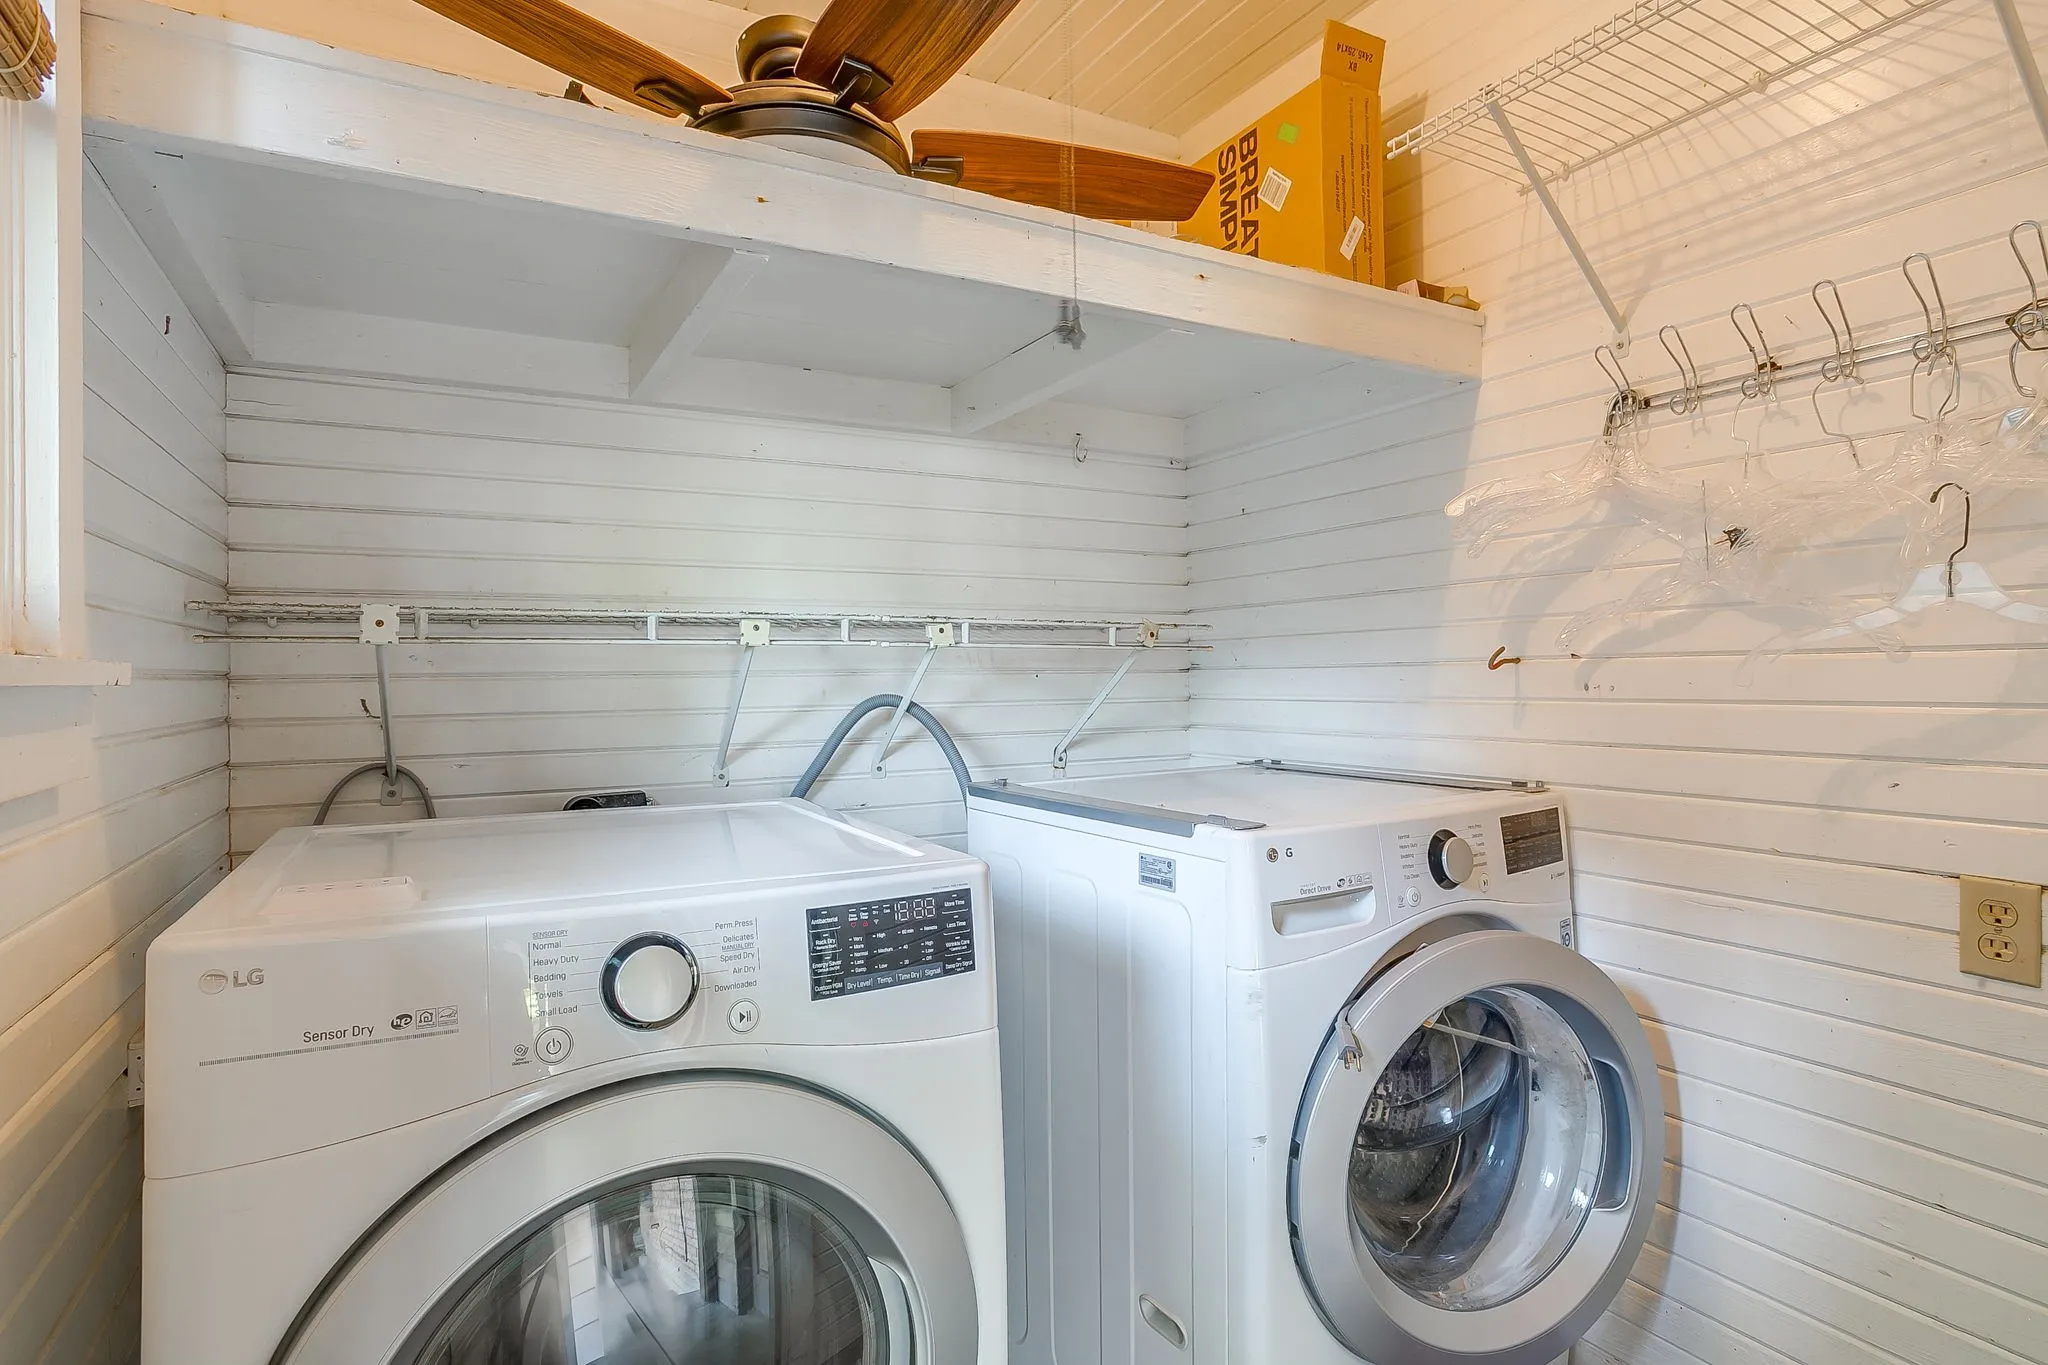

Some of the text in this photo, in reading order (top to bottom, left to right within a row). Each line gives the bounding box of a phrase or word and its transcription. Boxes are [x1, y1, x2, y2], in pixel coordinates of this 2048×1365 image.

[722, 933, 755, 944] Delicates
[532, 940, 562, 951] Normal
[533, 955, 580, 967] Heavy Duty
[719, 951, 755, 964] Speed Dry
[732, 965, 756, 975] Air Dry
[924, 967, 941, 977] Signal
[232, 967, 265, 988] LG
[533, 972, 567, 983] Bedding
[899, 971, 920, 981] Time Dry
[714, 979, 758, 993] Downloaded
[847, 978, 871, 990] Dry Level
[558, 1004, 578, 1015] Load
[303, 1024, 375, 1043] Sensor Dry
